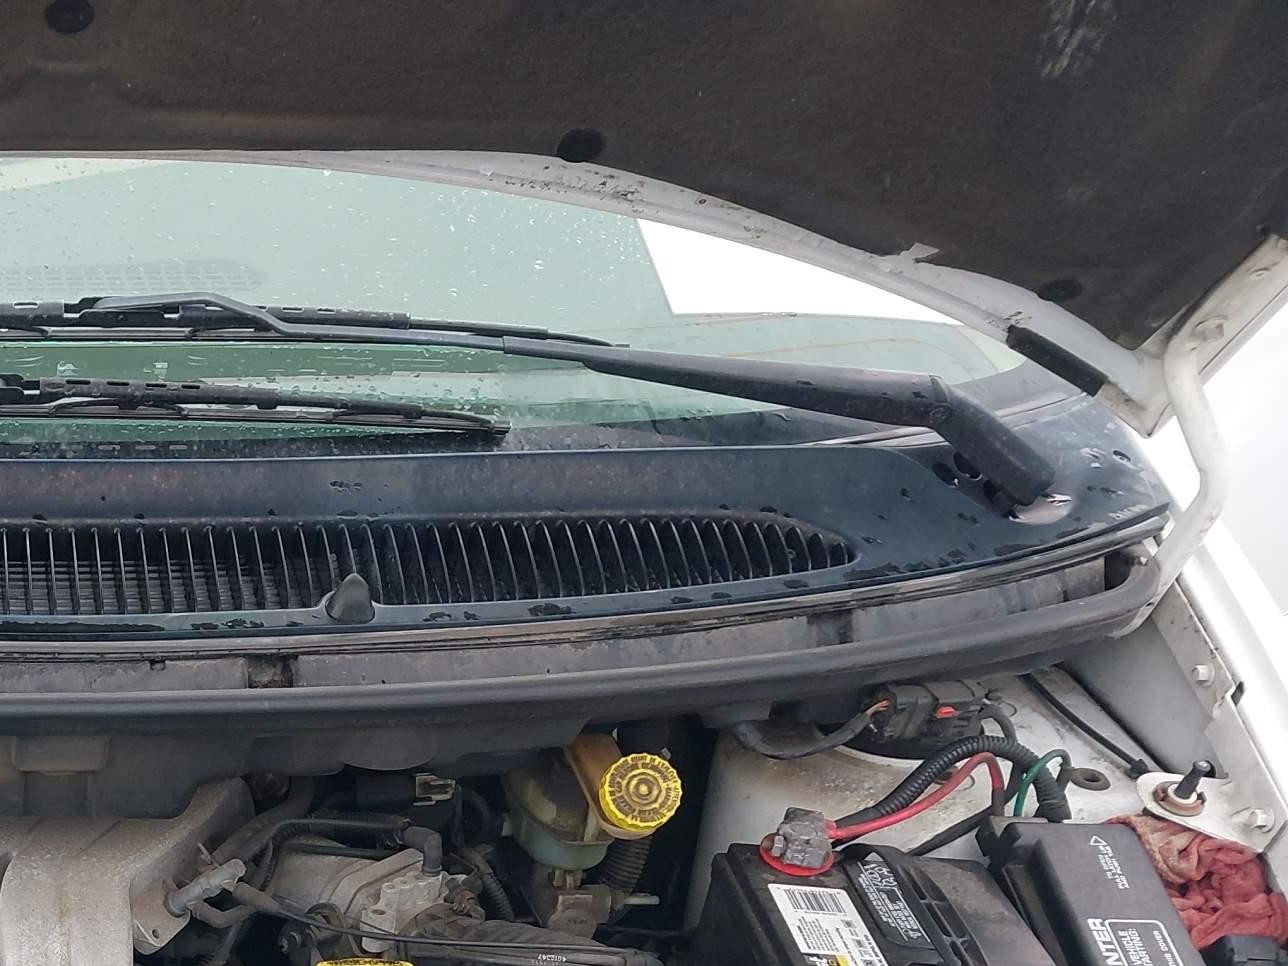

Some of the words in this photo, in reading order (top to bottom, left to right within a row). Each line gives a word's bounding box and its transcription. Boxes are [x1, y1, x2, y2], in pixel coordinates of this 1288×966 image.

[1117, 930, 1142, 964] VEHICLE
[1151, 930, 1168, 950] COVER
[1163, 953, 1177, 966] THIS
